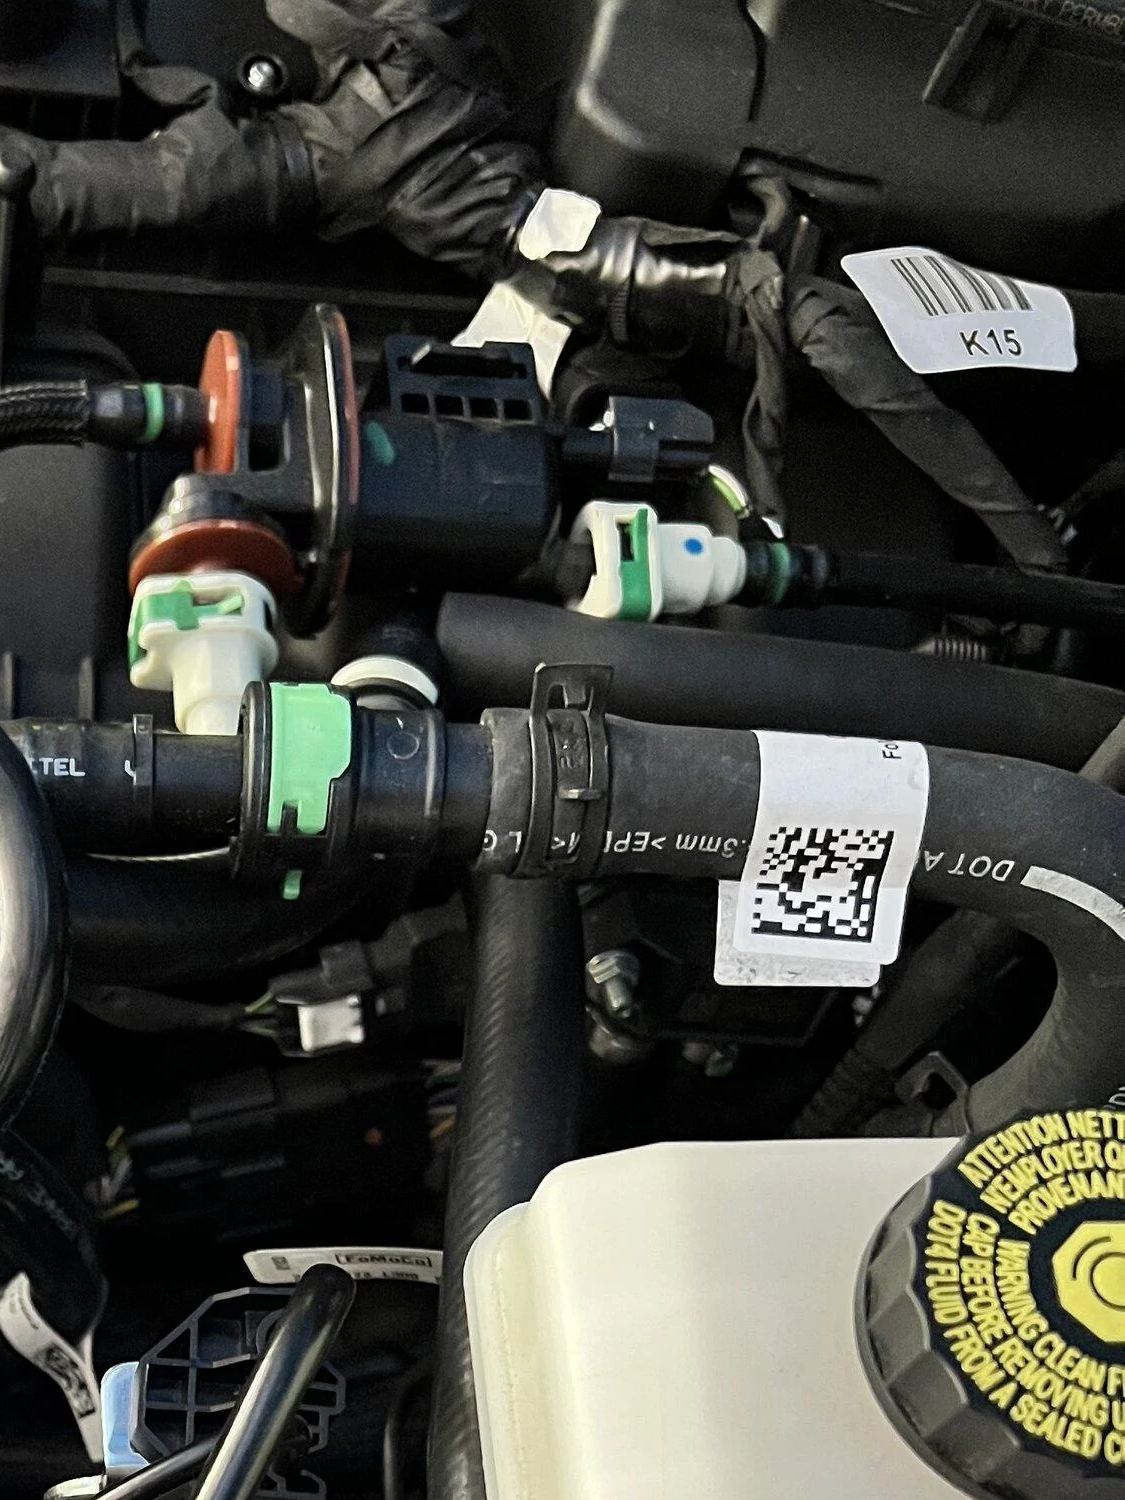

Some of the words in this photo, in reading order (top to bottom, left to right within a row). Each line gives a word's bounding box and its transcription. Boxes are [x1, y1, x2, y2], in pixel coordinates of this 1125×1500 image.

[959, 329, 1022, 356] K15
[947, 856, 1016, 883] DOT
[958, 1113, 1069, 1189] ATTENTION
[962, 1212, 1001, 1258] CAP
[925, 1261, 970, 1325] FLUID
[960, 1256, 1015, 1346] BEFORE
[995, 1238, 1050, 1342] WARNING
[1032, 1331, 1108, 1393] CLEAN
[942, 1323, 1006, 1392] FROM
[991, 1335, 1111, 1428] REMOVING
[988, 1381, 1019, 1410] A
[1009, 1393, 1104, 1461] SEALED
